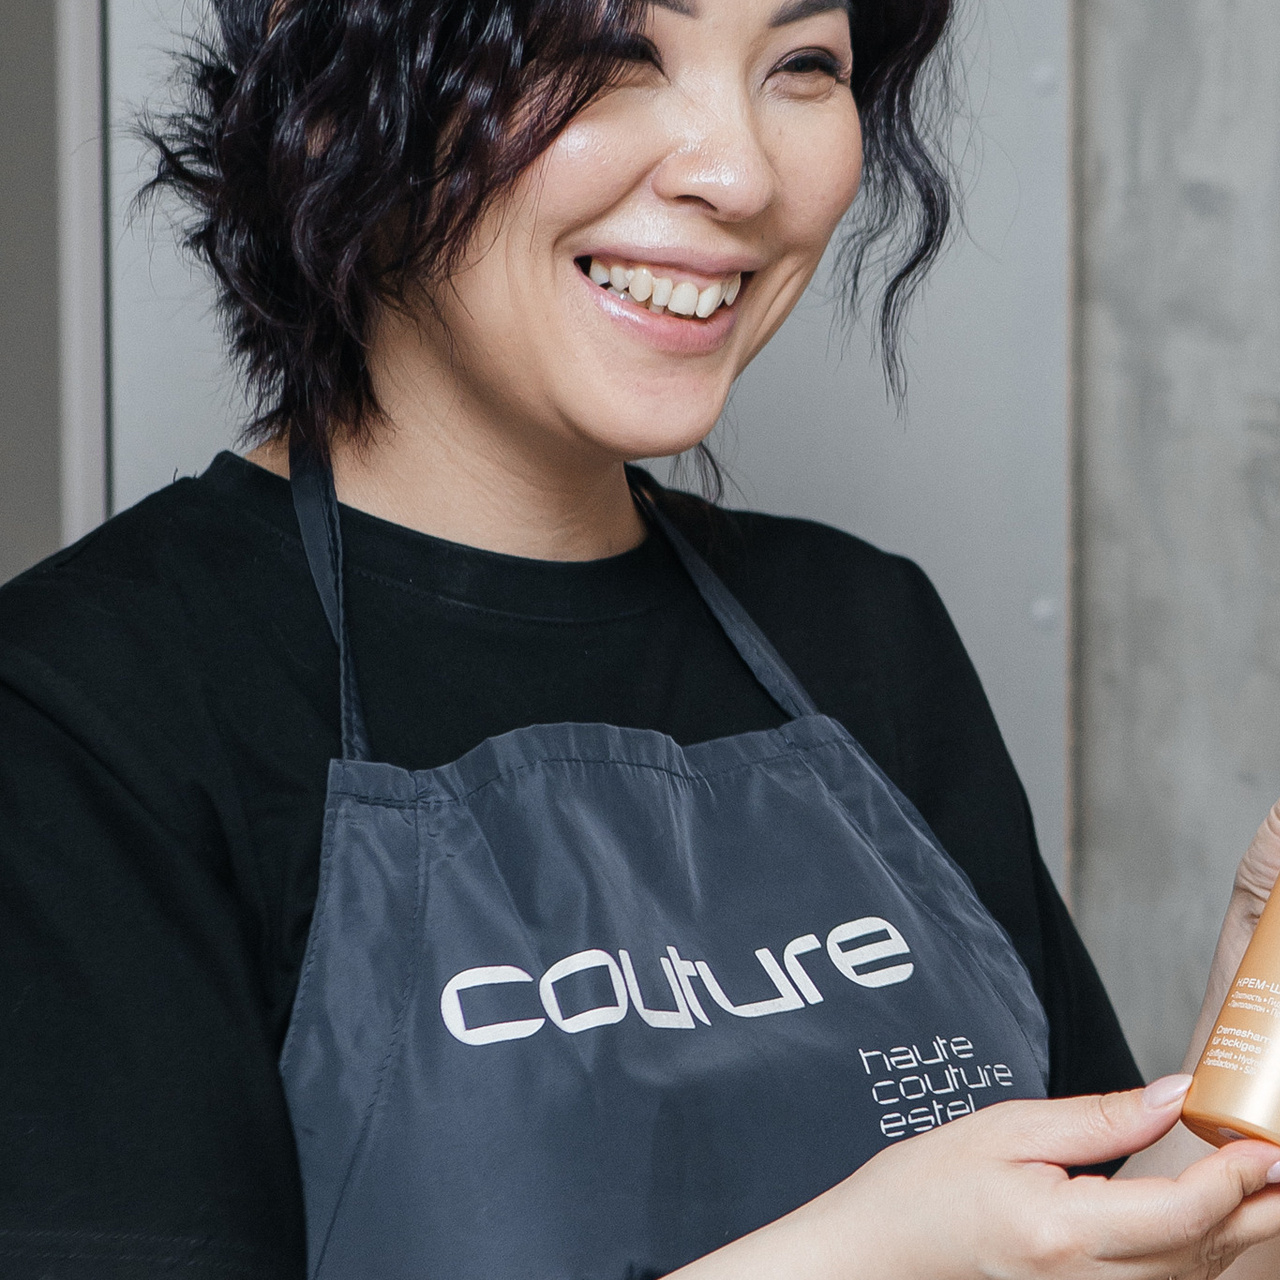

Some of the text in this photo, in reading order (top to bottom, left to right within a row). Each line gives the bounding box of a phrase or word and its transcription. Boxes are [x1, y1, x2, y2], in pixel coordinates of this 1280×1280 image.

[440, 916, 914, 1046] couture
[858, 1035, 974, 1075] haute
[871, 1063, 1014, 1105] couture
[880, 1093, 976, 1138] estel
